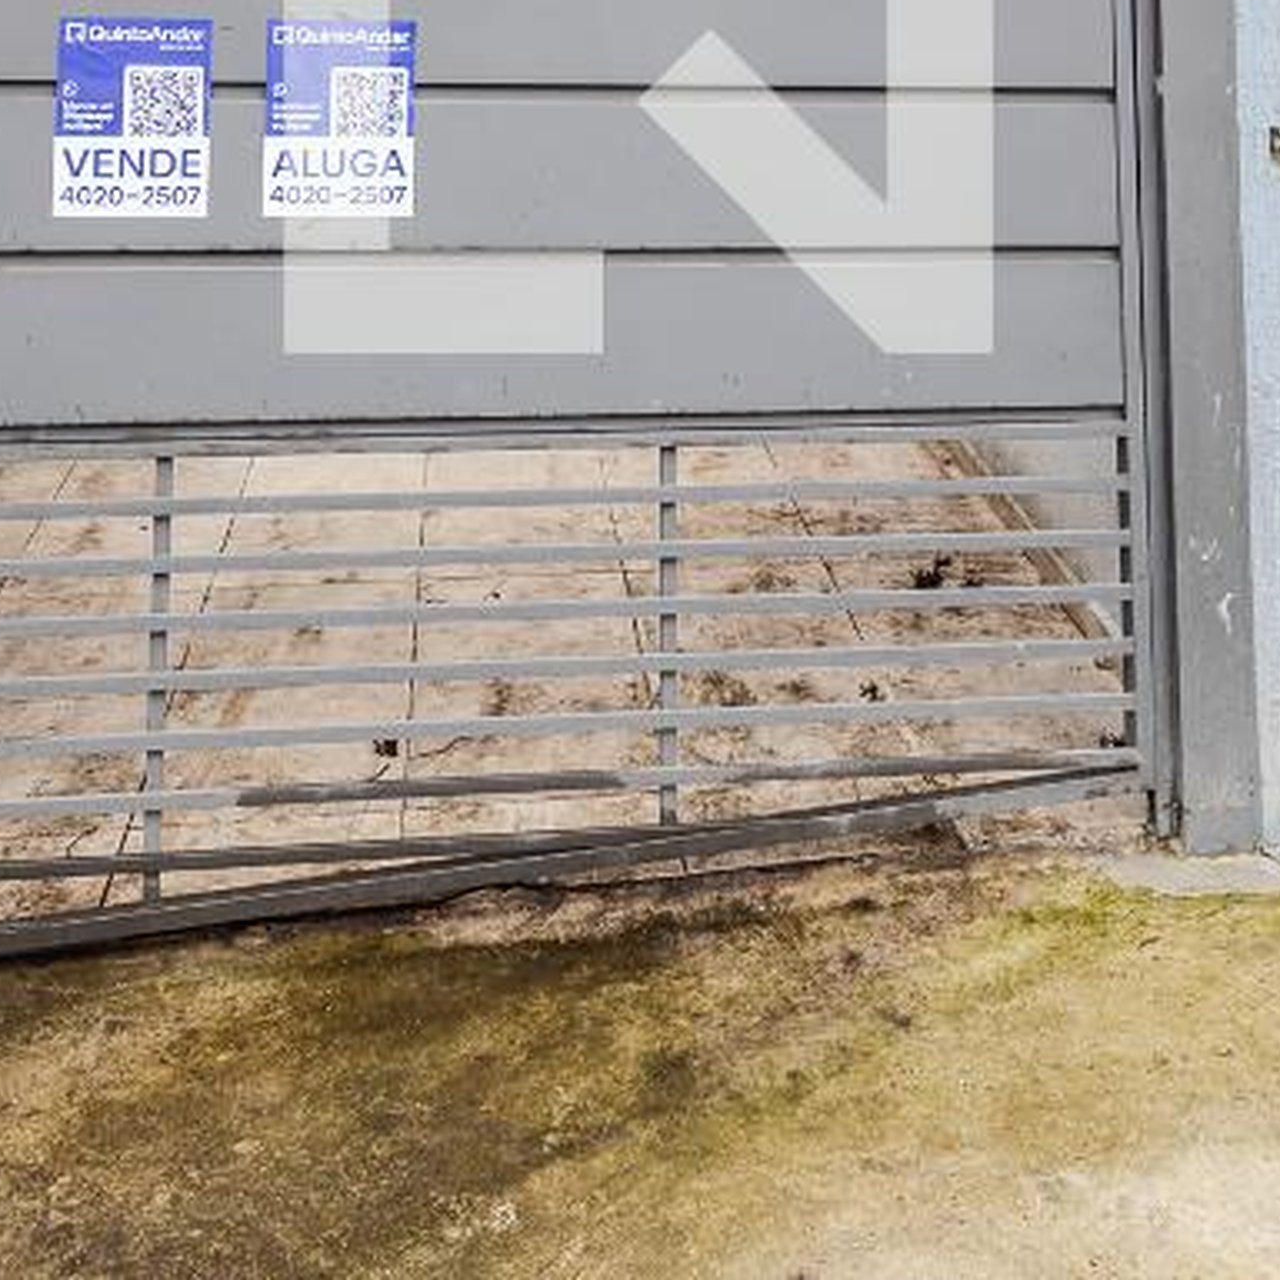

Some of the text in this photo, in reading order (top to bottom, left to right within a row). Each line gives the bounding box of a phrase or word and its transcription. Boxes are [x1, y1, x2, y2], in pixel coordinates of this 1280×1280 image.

[62, 148, 201, 178] VENDE
[272, 148, 406, 178] ALUGA
[59, 185, 201, 206] 4020-2507
[270, 185, 407, 205] 4020-2507
